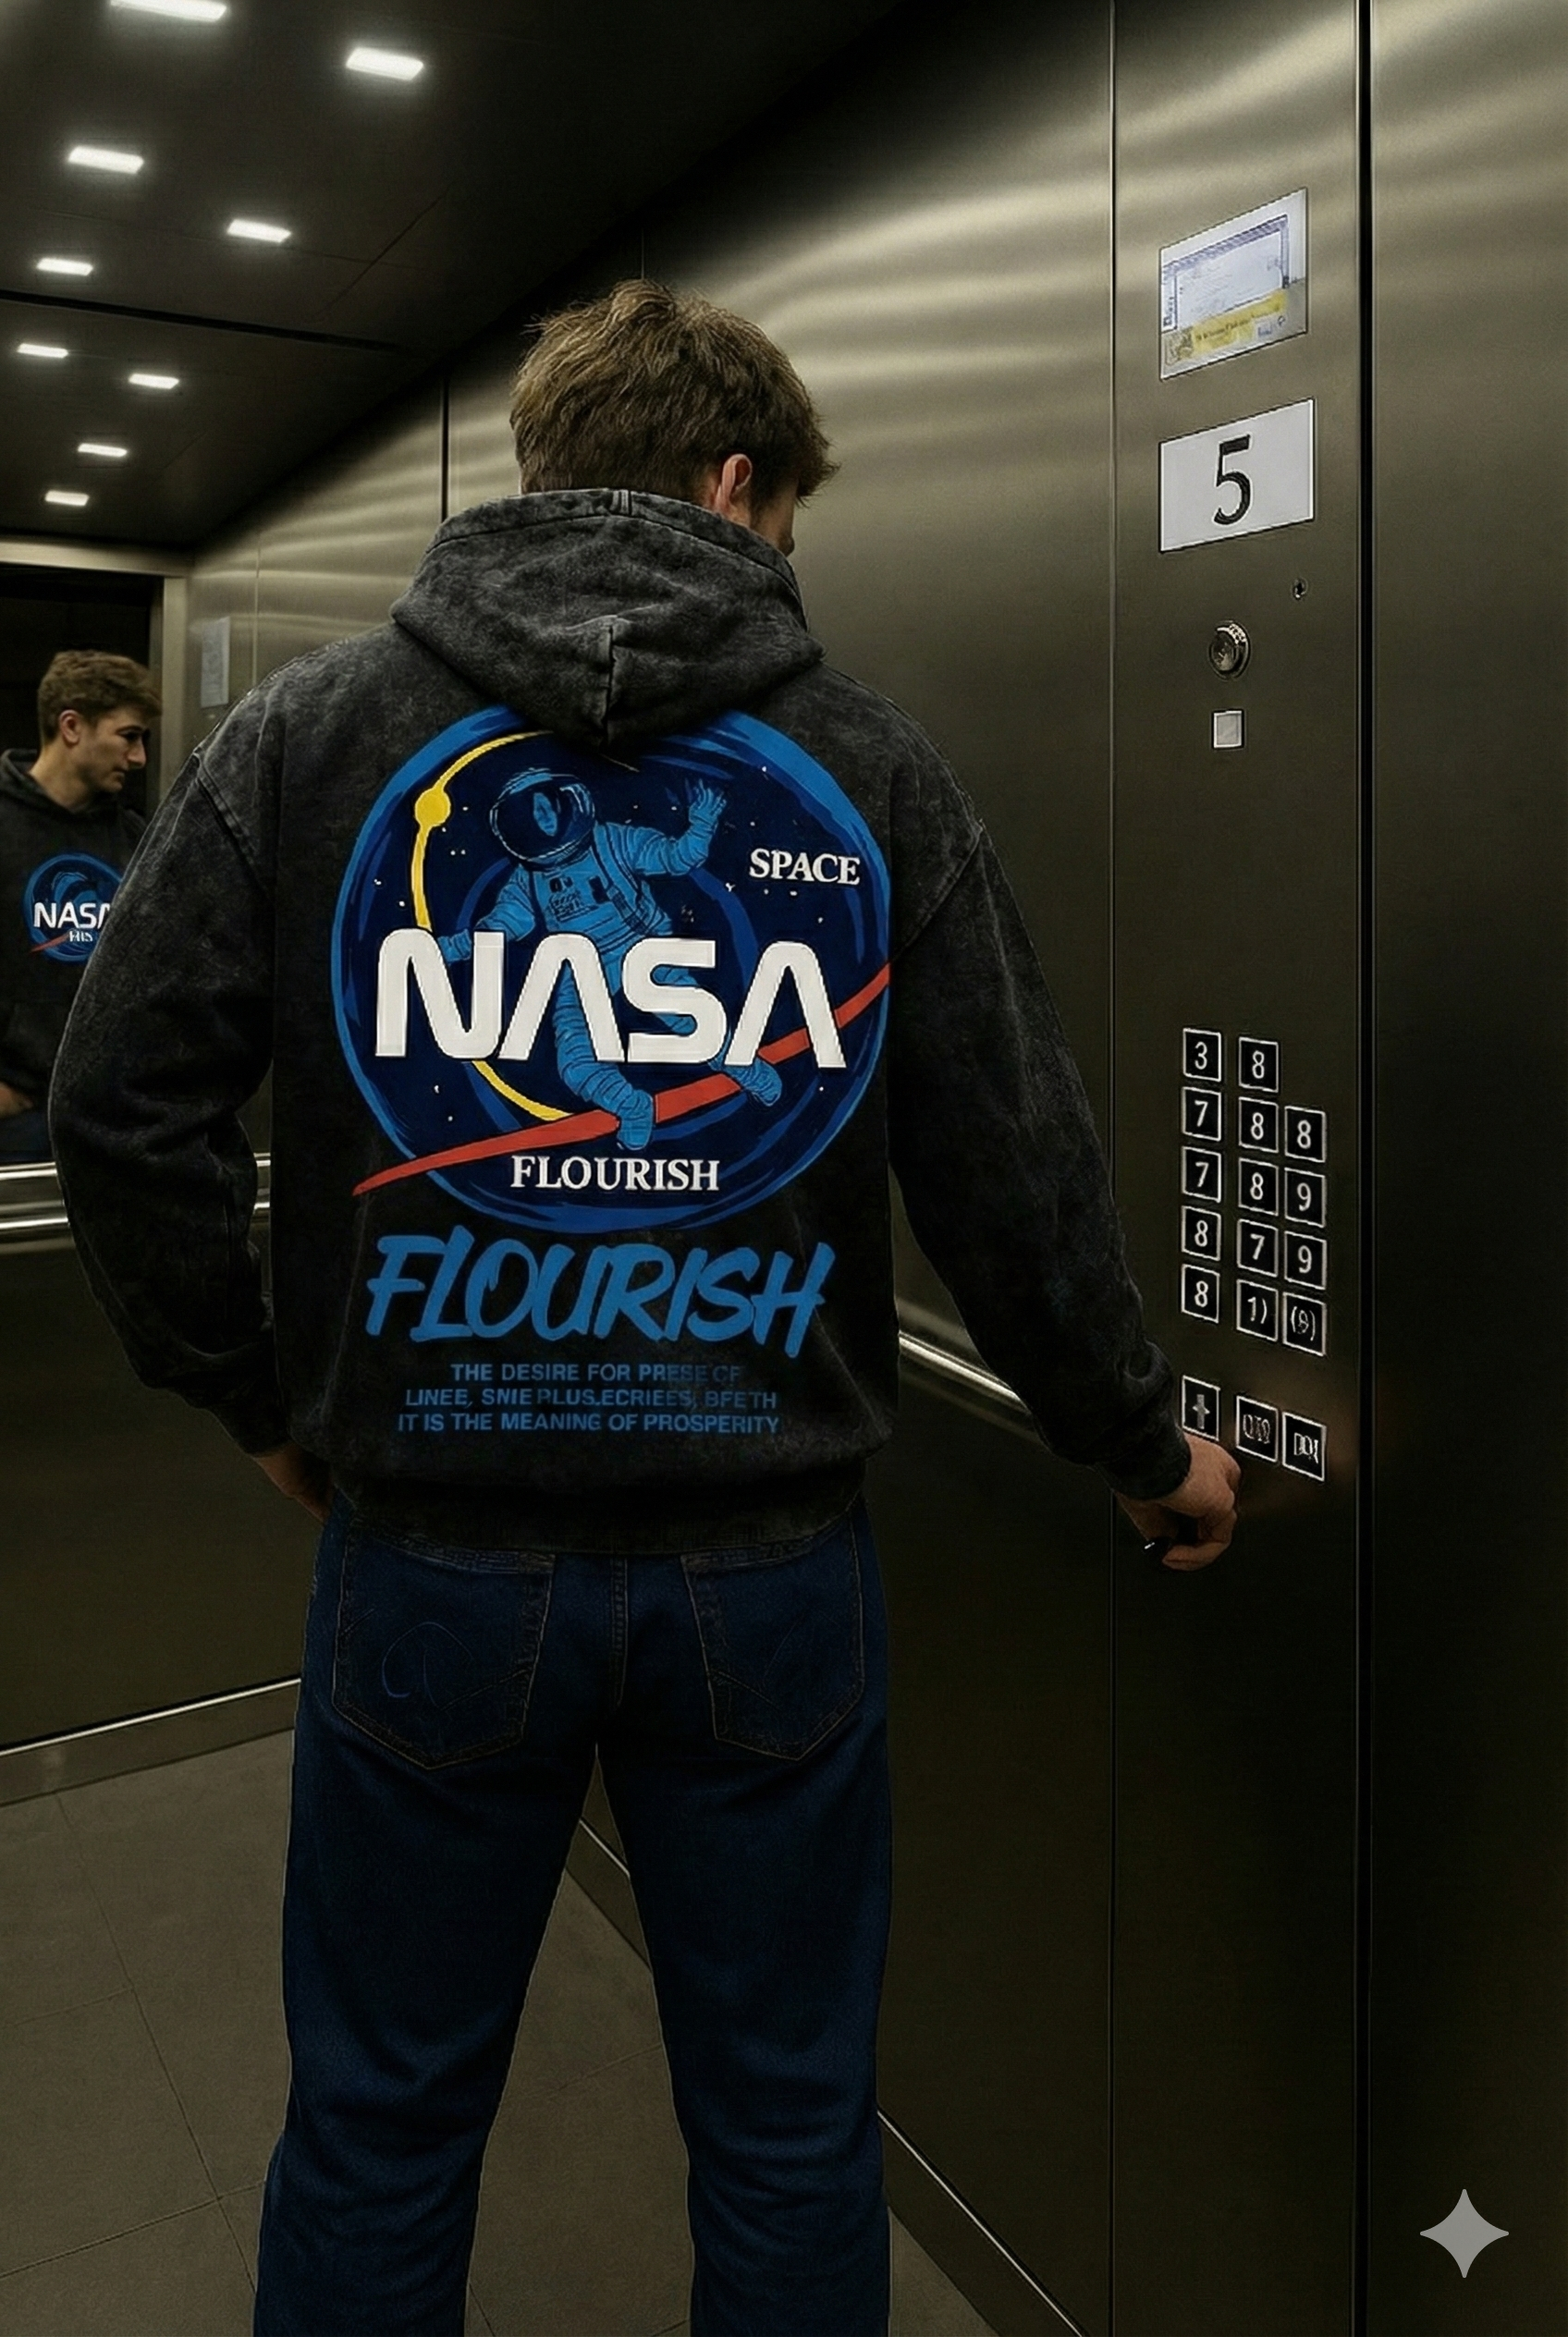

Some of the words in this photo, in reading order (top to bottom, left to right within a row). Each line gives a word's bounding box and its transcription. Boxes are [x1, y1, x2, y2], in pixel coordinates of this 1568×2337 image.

[1213, 434, 1252, 525] 5
[749, 848, 861, 885] SPACE
[375, 928, 847, 1069] NASA
[1194, 1041, 1208, 1071] 3
[1251, 1049, 1266, 1080] 8
[1194, 1099, 1209, 1128] 7
[1250, 1111, 1265, 1141] 8
[1296, 1120, 1312, 1150] 8
[509, 1155, 720, 1192] FLOURISH
[1194, 1161, 1209, 1189] 7
[1249, 1171, 1265, 1201] 8
[1296, 1181, 1313, 1212] 9
[1194, 1219, 1208, 1248] 8
[1250, 1233, 1266, 1261] 7
[1297, 1244, 1313, 1274] 9
[365, 1225, 836, 1359] FLOURISH
[1194, 1280, 1209, 1308] 8
[450, 1364, 493, 1381] THE
[501, 1364, 580, 1381] DESIRE
[587, 1364, 631, 1381] FOR
[398, 1413, 420, 1432] IT
[423, 1413, 445, 1432] IS
[450, 1413, 493, 1431] THE
[501, 1413, 602, 1431] MEANING
[608, 1413, 639, 1432] OF
[643, 1413, 779, 1434] PROSPERITY
